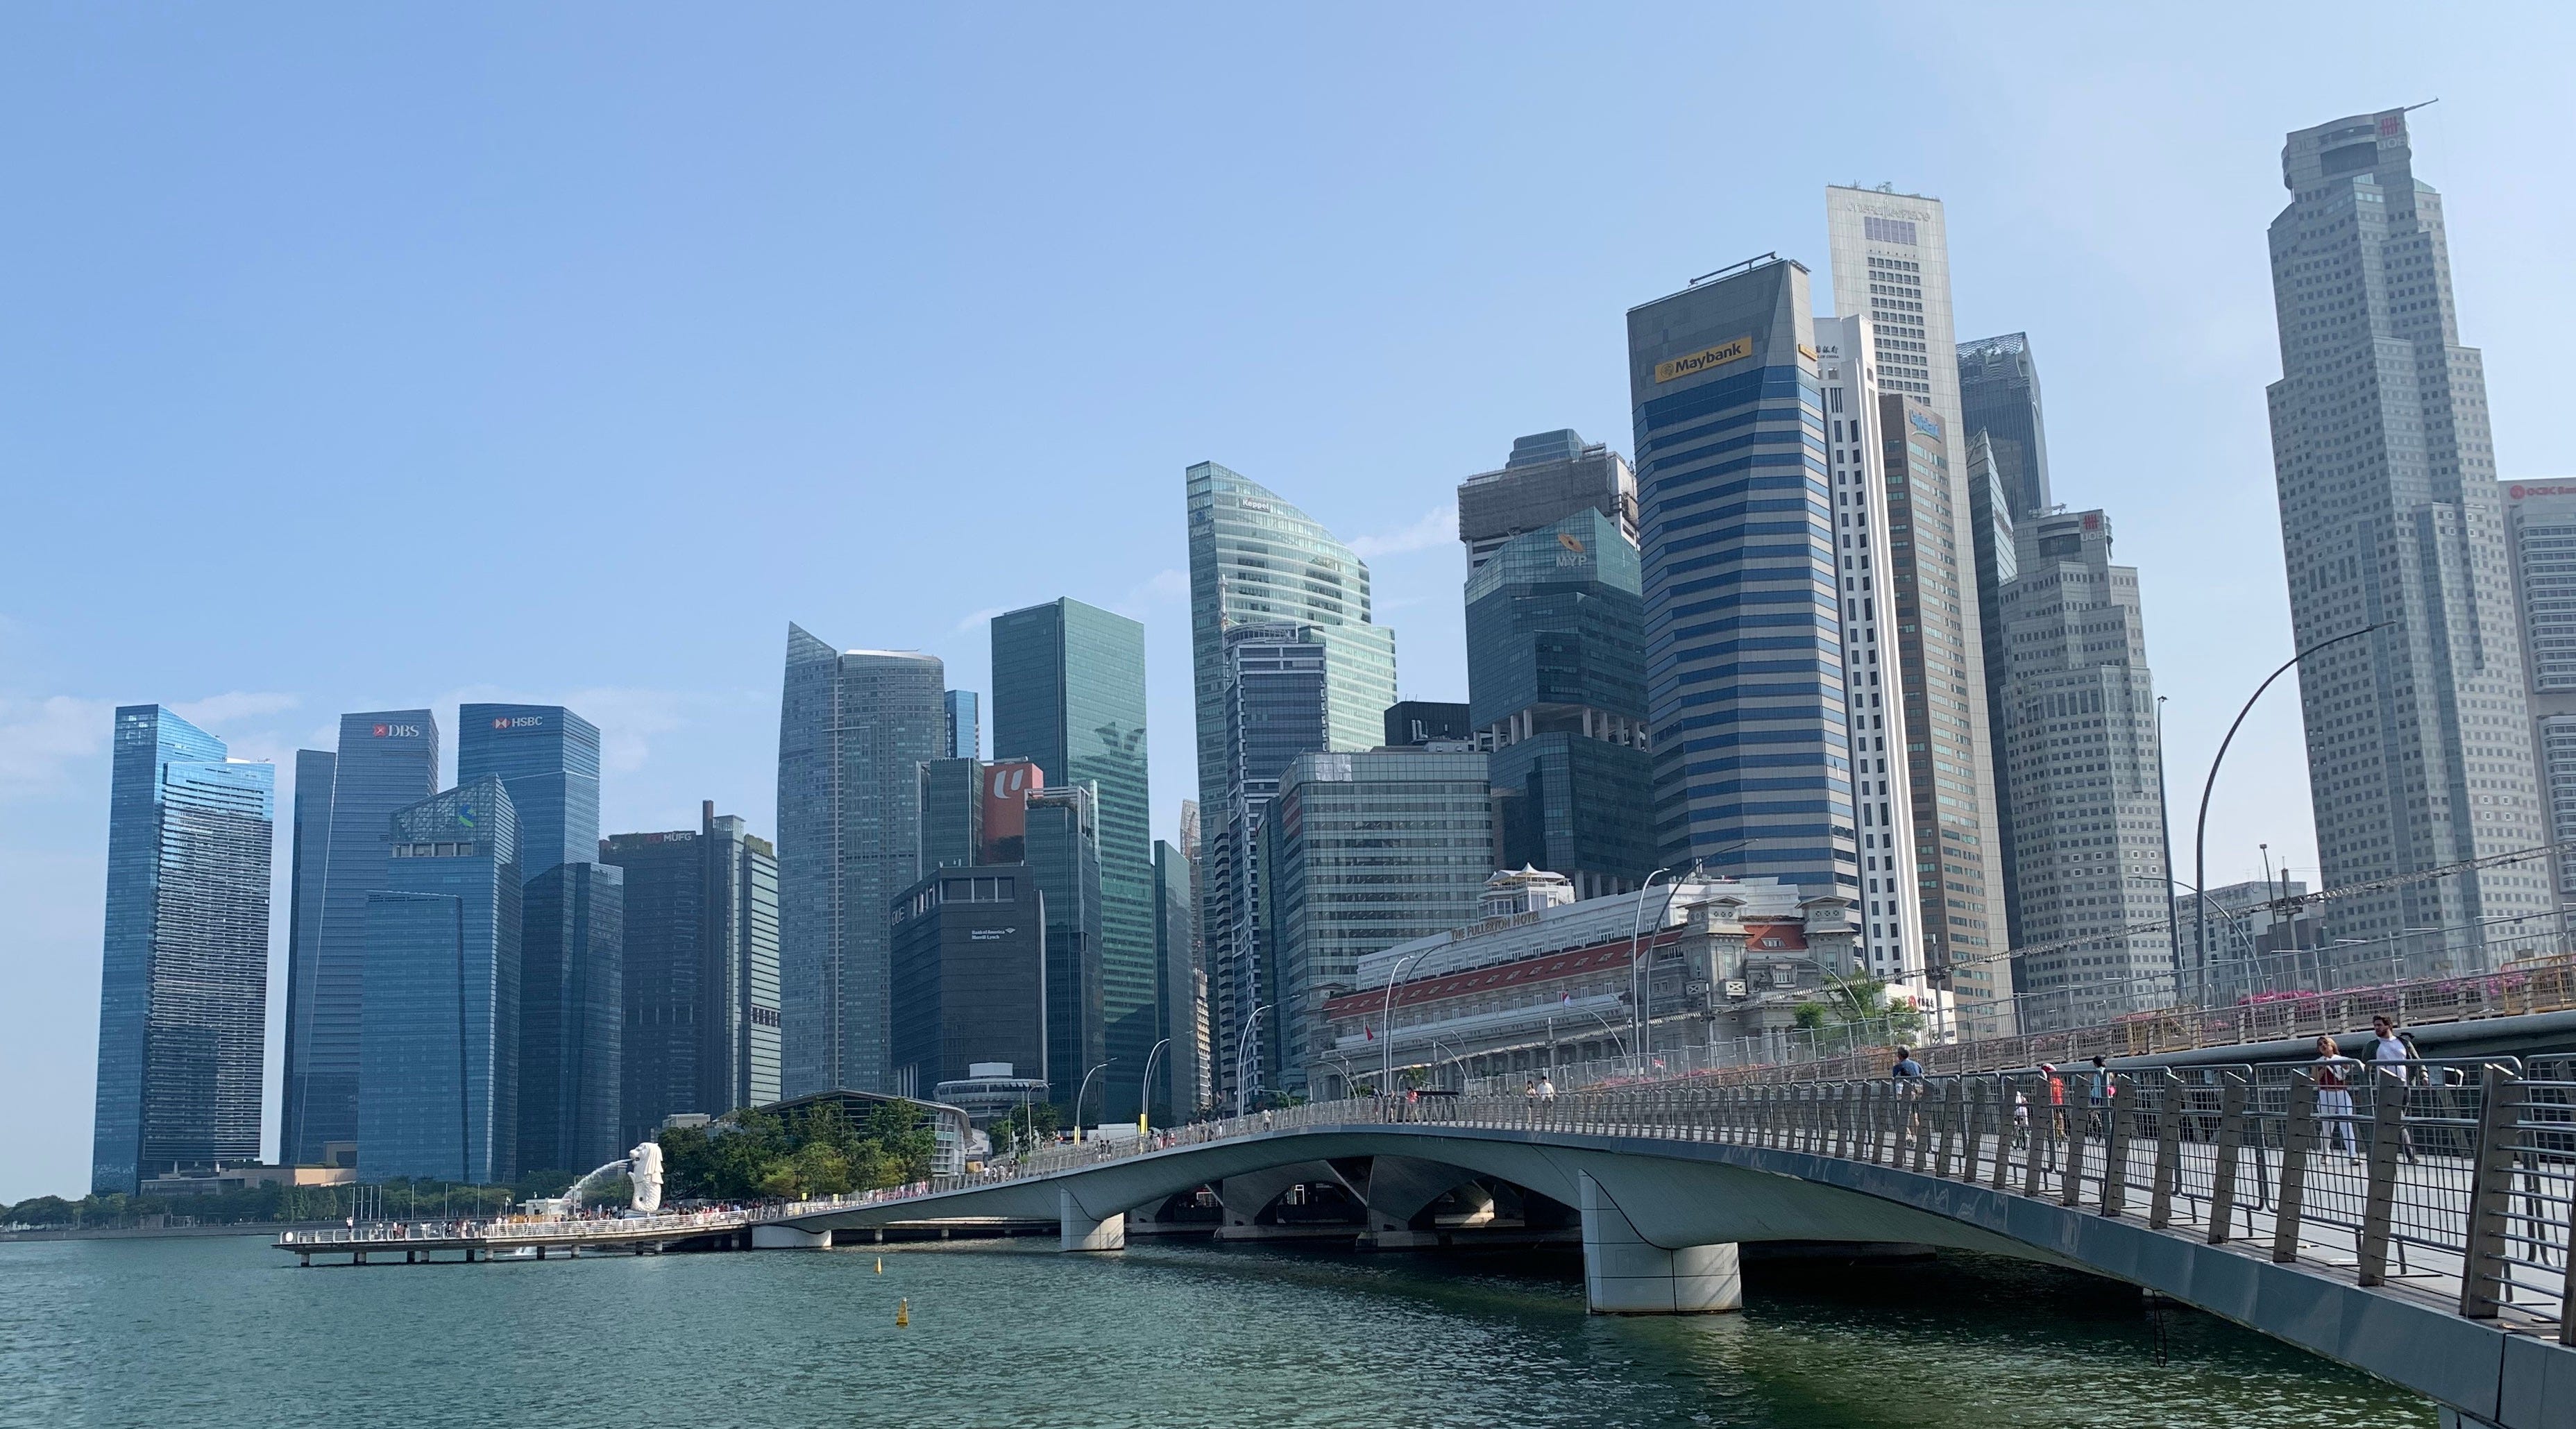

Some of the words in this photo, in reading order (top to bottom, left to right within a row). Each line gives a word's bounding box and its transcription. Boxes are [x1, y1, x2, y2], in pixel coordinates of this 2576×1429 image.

[2376, 136, 2406, 150] UOB
[1676, 344, 1742, 373] Maybank
[2527, 487, 2557, 496] OCBC
[1242, 499, 1269, 510] Keppel
[2081, 531, 2103, 541] UOB
[1556, 555, 1587, 567] MYP
[511, 716, 543, 727] HSBC
[389, 725, 420, 737] DBS
[663, 832, 692, 842] MUFG
[1450, 928, 1466, 940] THE
[1467, 918, 1511, 937] FULLERTON
[1513, 911, 1539, 927] HOTEL
